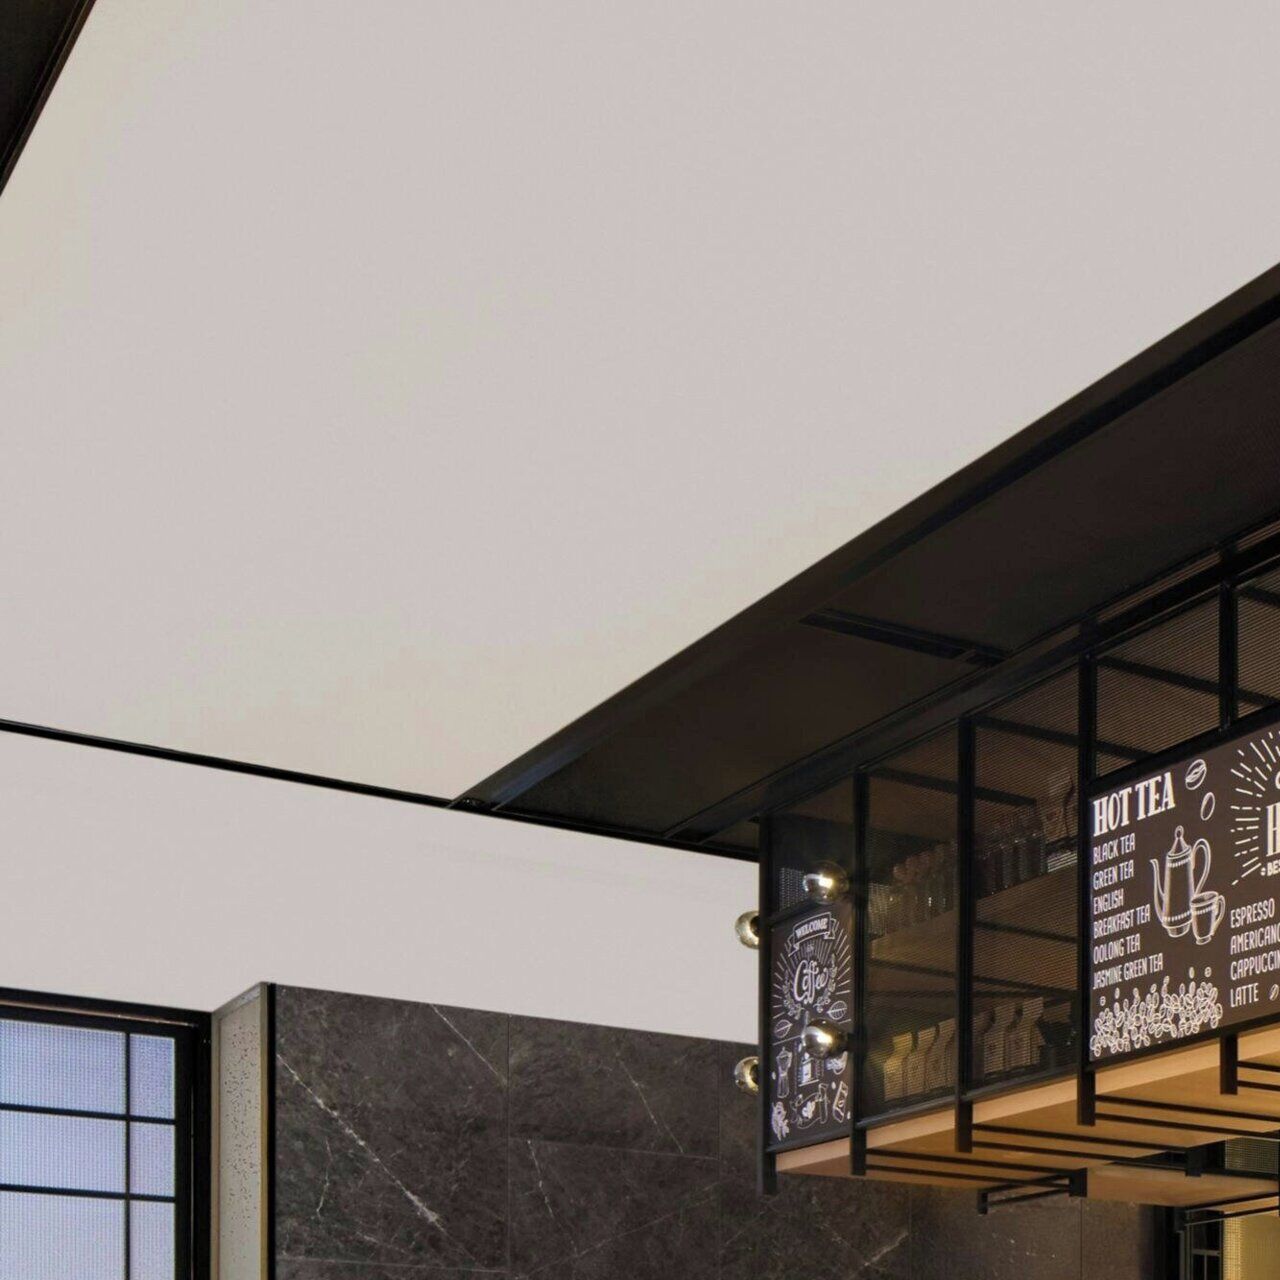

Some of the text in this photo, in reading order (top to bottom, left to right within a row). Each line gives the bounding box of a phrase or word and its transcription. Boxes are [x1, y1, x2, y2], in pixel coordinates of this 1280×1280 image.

[1093, 771, 1176, 837] HOT TEA
[1093, 832, 1136, 865] BLACK TEA
[1092, 859, 1135, 891] GREEN TEA
[1093, 888, 1124, 915] ENGLISH
[1230, 898, 1275, 928] ESPRESSO
[795, 918, 828, 938] WELCOME
[1093, 903, 1151, 939] BREAKFAST TEA
[1093, 933, 1141, 965] OOLONG TEA
[794, 960, 829, 1004] Coffee
[1092, 952, 1164, 990] JASMINE GREEN TEA
[1230, 982, 1259, 1008] LATTE
